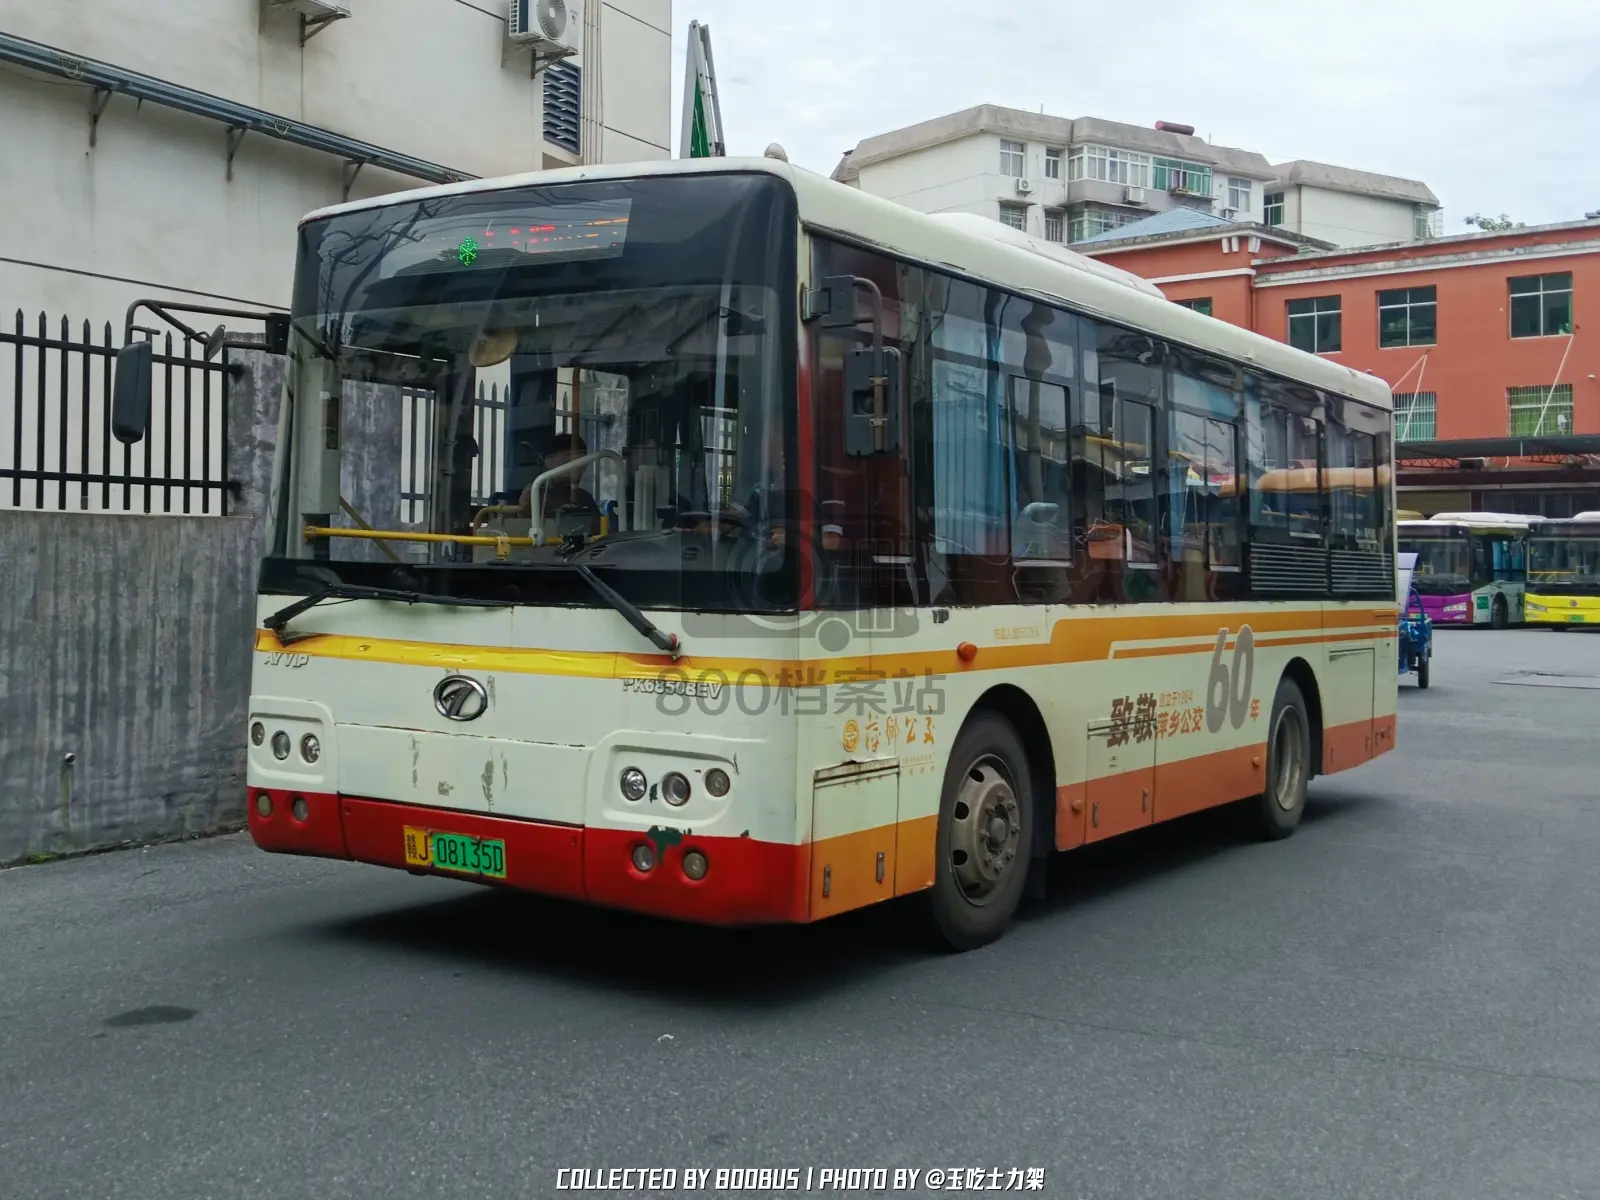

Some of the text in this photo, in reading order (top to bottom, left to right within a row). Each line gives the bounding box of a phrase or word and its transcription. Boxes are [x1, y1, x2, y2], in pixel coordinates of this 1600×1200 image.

[623, 678, 723, 699] PK6850BEV
[1107, 624, 1260, 748] 致敬 萍乡公交 60 年
